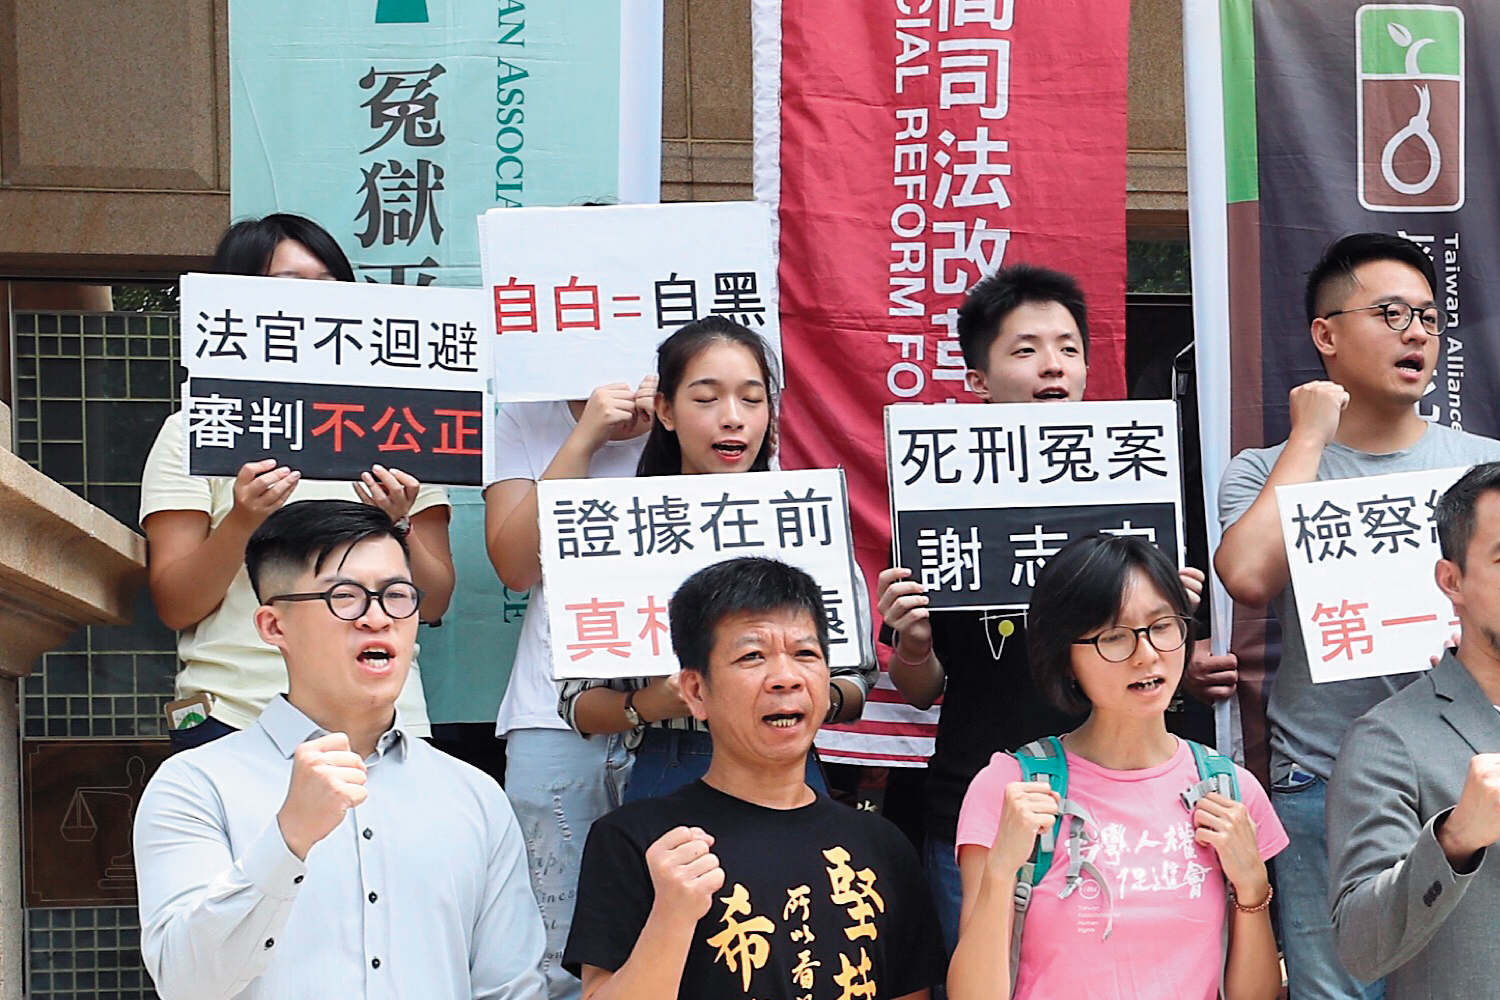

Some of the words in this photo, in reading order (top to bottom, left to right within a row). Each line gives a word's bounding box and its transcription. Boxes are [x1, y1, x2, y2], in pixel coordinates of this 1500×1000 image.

[889, 108, 929, 316] REFORM
[1444, 233, 1461, 328] Taiwan
[195, 309, 479, 372] 法官不迴避
[887, 334, 926, 404] FO
[1447, 337, 1465, 431] Alliance
[189, 394, 483, 454] 審判不公正
[898, 420, 1168, 486] 死刑冤案
[553, 487, 833, 559] 證據在前
[917, 520, 1159, 592] 謝志
[1292, 489, 1439, 563] 檢察
[1311, 600, 1463, 662] 第一
